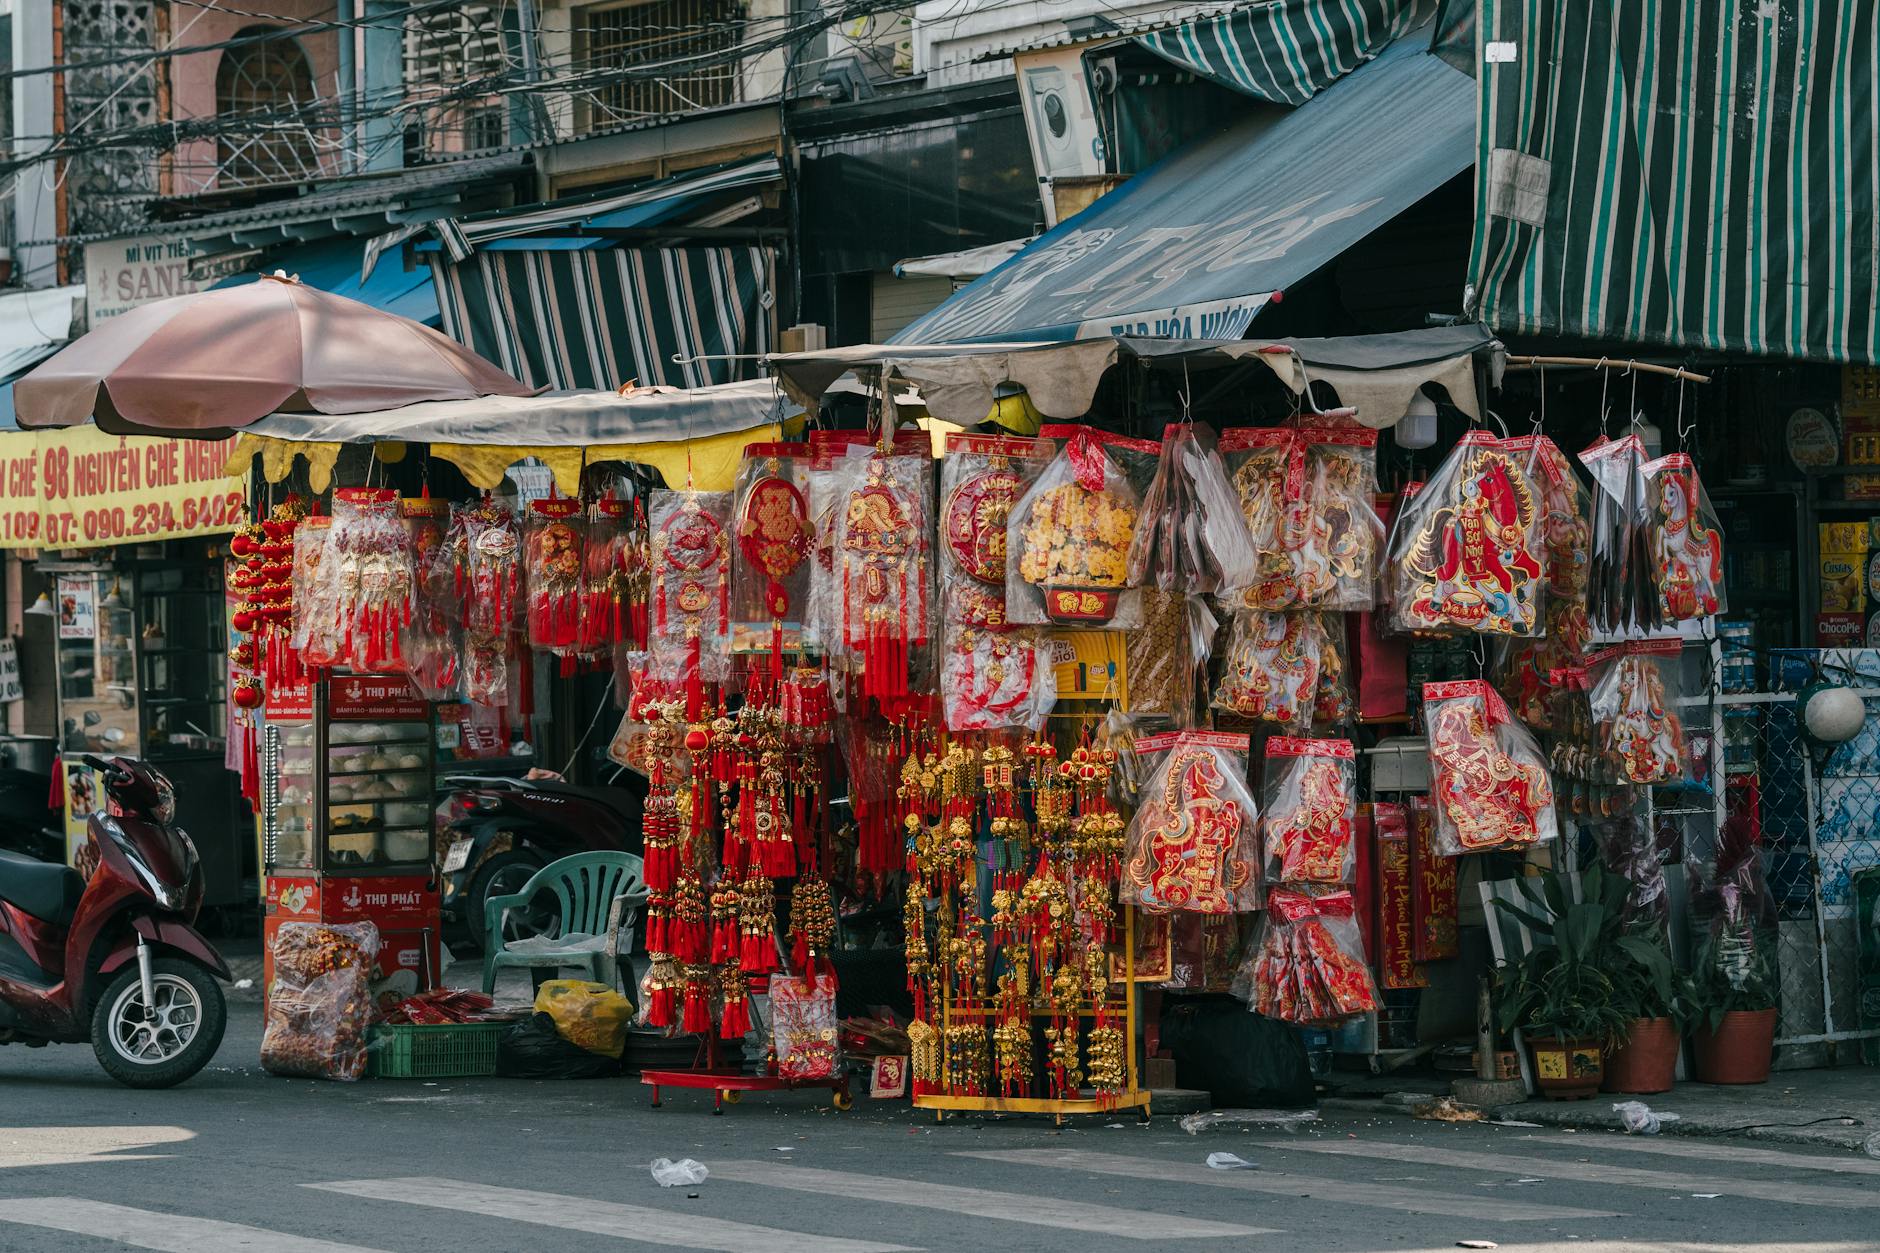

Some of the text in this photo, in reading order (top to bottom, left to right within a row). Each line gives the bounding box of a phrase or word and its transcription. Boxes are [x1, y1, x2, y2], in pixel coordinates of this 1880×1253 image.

[126, 243, 140, 263] MÌ
[144, 244, 163, 264] VỊT
[44, 445, 69, 501] 98
[83, 492, 243, 541] 090.234.6402
[365, 687, 385, 699] THỌ
[365, 890, 422, 907] THỌ PHÁT
